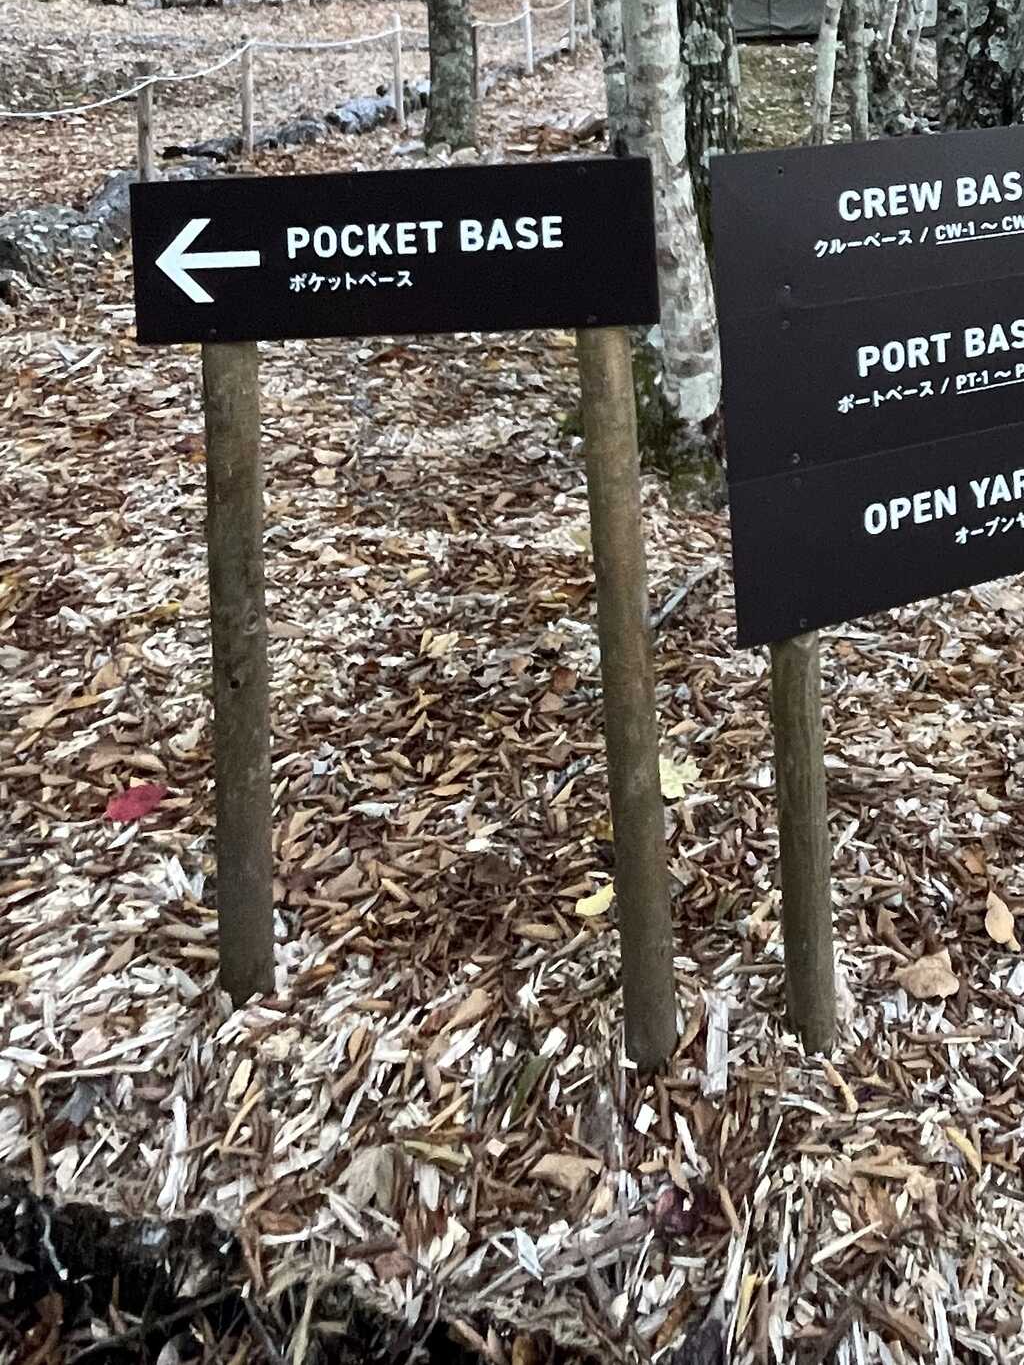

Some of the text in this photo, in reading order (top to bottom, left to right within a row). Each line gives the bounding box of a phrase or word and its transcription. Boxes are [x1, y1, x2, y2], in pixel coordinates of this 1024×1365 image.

[838, 179, 942, 222] CREW
[286, 215, 564, 260] POCKET BASE
[813, 229, 913, 258] クルーベース
[934, 221, 976, 241] CW-1
[289, 270, 413, 293] ポケットベース
[857, 332, 951, 378] PORT
[837, 380, 934, 414] ポートベース
[955, 370, 990, 391] PT-1
[863, 485, 957, 535] OPEN
